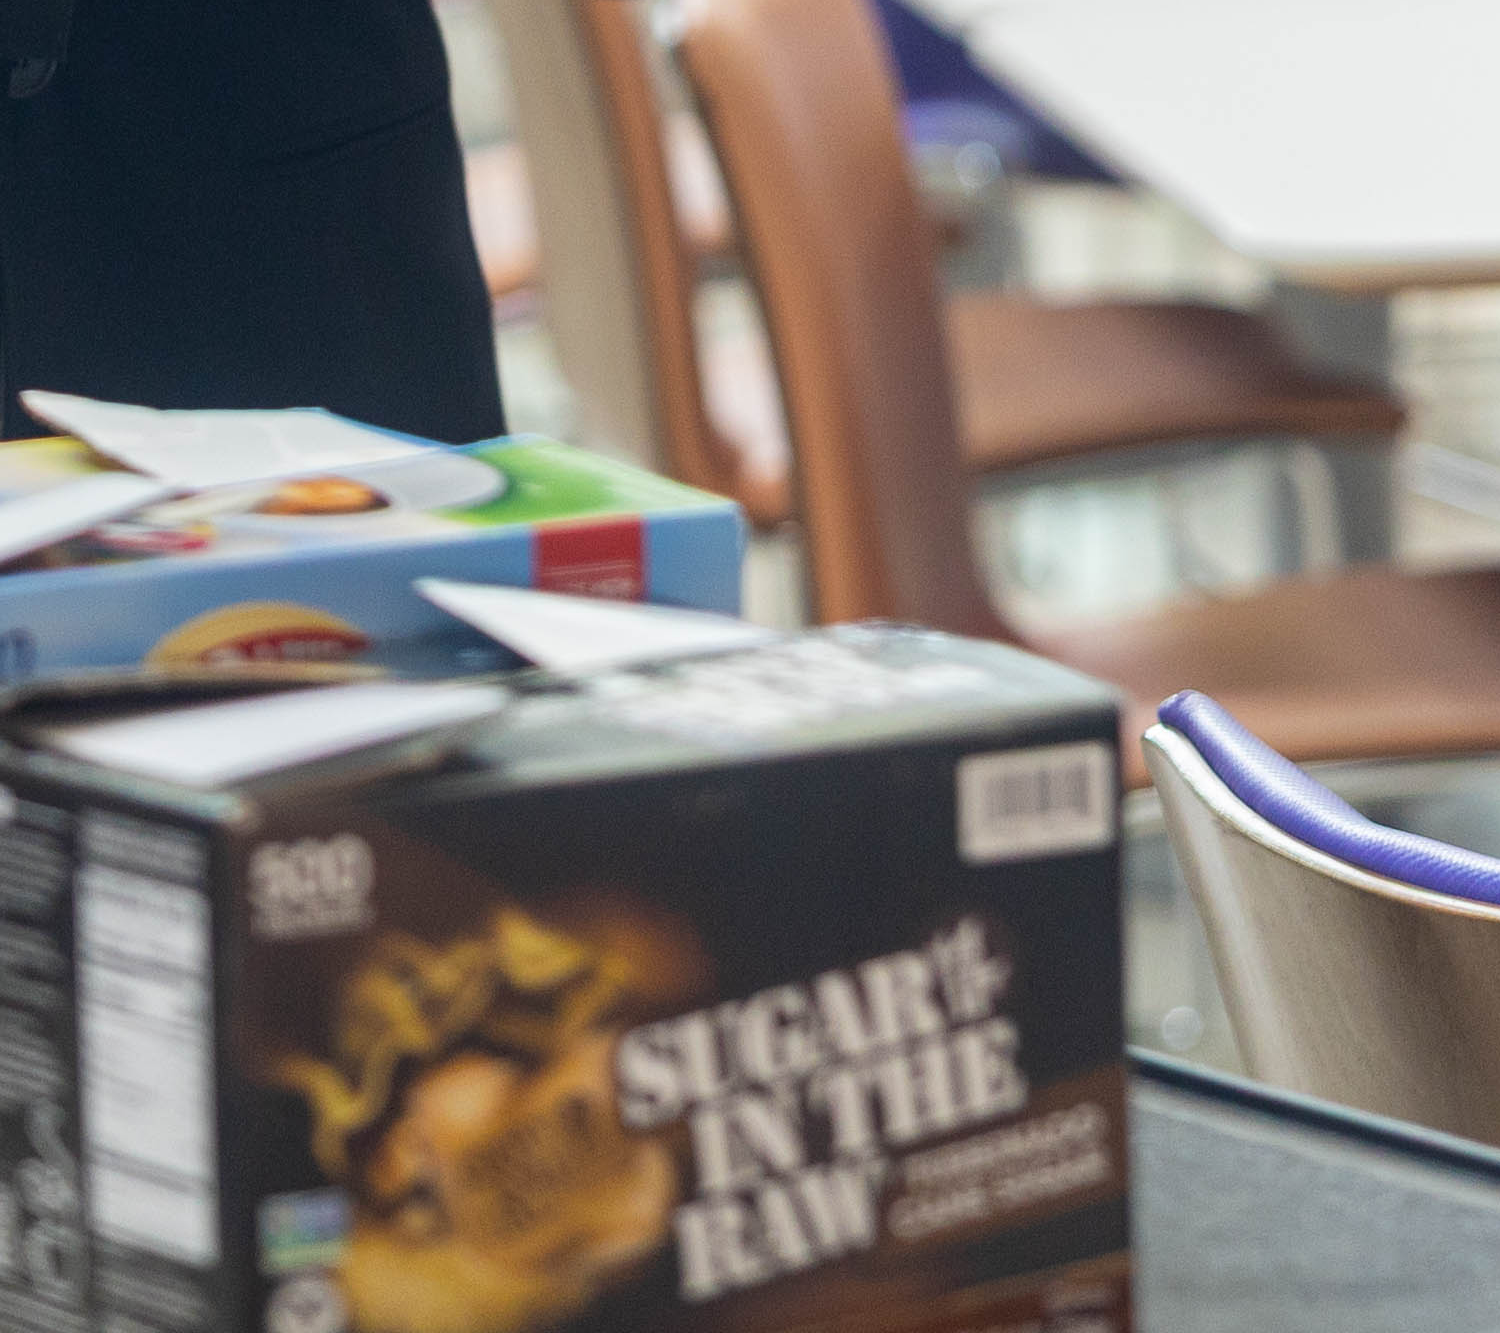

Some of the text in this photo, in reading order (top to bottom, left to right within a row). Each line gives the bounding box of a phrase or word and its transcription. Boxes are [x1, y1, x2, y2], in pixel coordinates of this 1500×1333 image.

[617, 947, 950, 1131] SUGAR
[690, 1078, 808, 1195] IN
[805, 1015, 1029, 1161] THE
[673, 1159, 886, 1303] RAW
